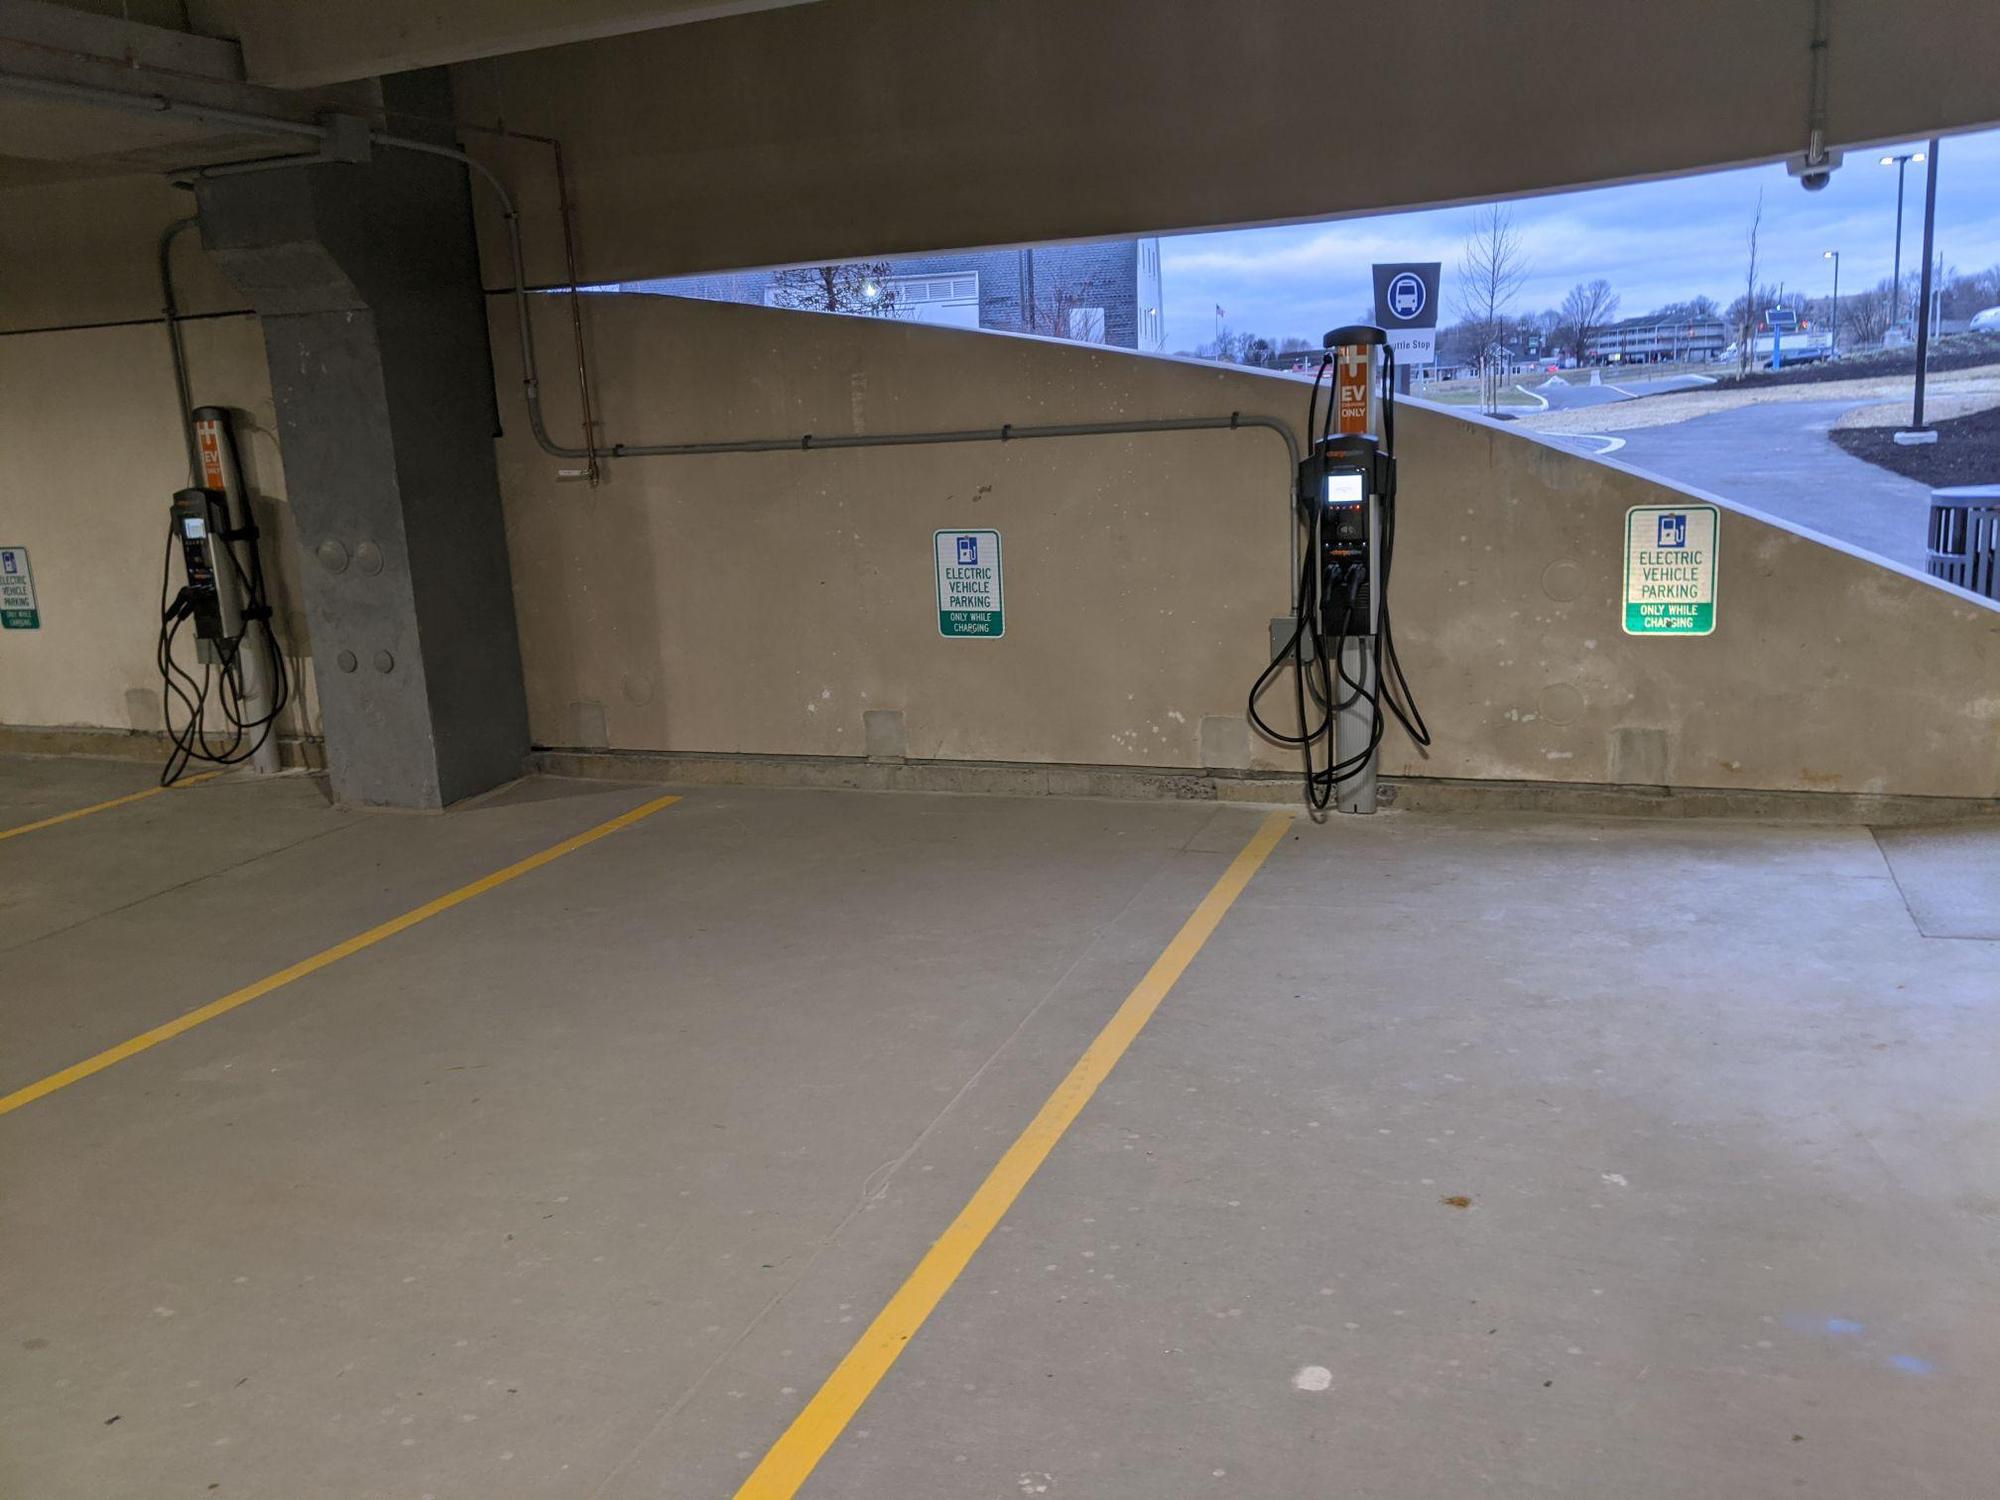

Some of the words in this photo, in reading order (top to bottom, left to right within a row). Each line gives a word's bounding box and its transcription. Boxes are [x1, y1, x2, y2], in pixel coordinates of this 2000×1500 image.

[1412, 340, 1431, 351] Stop
[1342, 385, 1365, 401] EV
[1342, 408, 1366, 417] ONLY
[204, 451, 219, 463] EV
[1639, 551, 1703, 565] ELECTRIC
[945, 568, 992, 580] ELECTRIC
[1643, 567, 1699, 581] VEHICLE
[949, 582, 990, 593] VEHICLE
[1642, 585, 1698, 599] PARKING
[950, 596, 991, 608] PARKING
[1640, 604, 1665, 616] ONLY
[1668, 604, 1699, 616] WHILE
[950, 613, 968, 622] ONLY
[970, 613, 992, 622] WHILE
[953, 623, 990, 633] CHARGING
